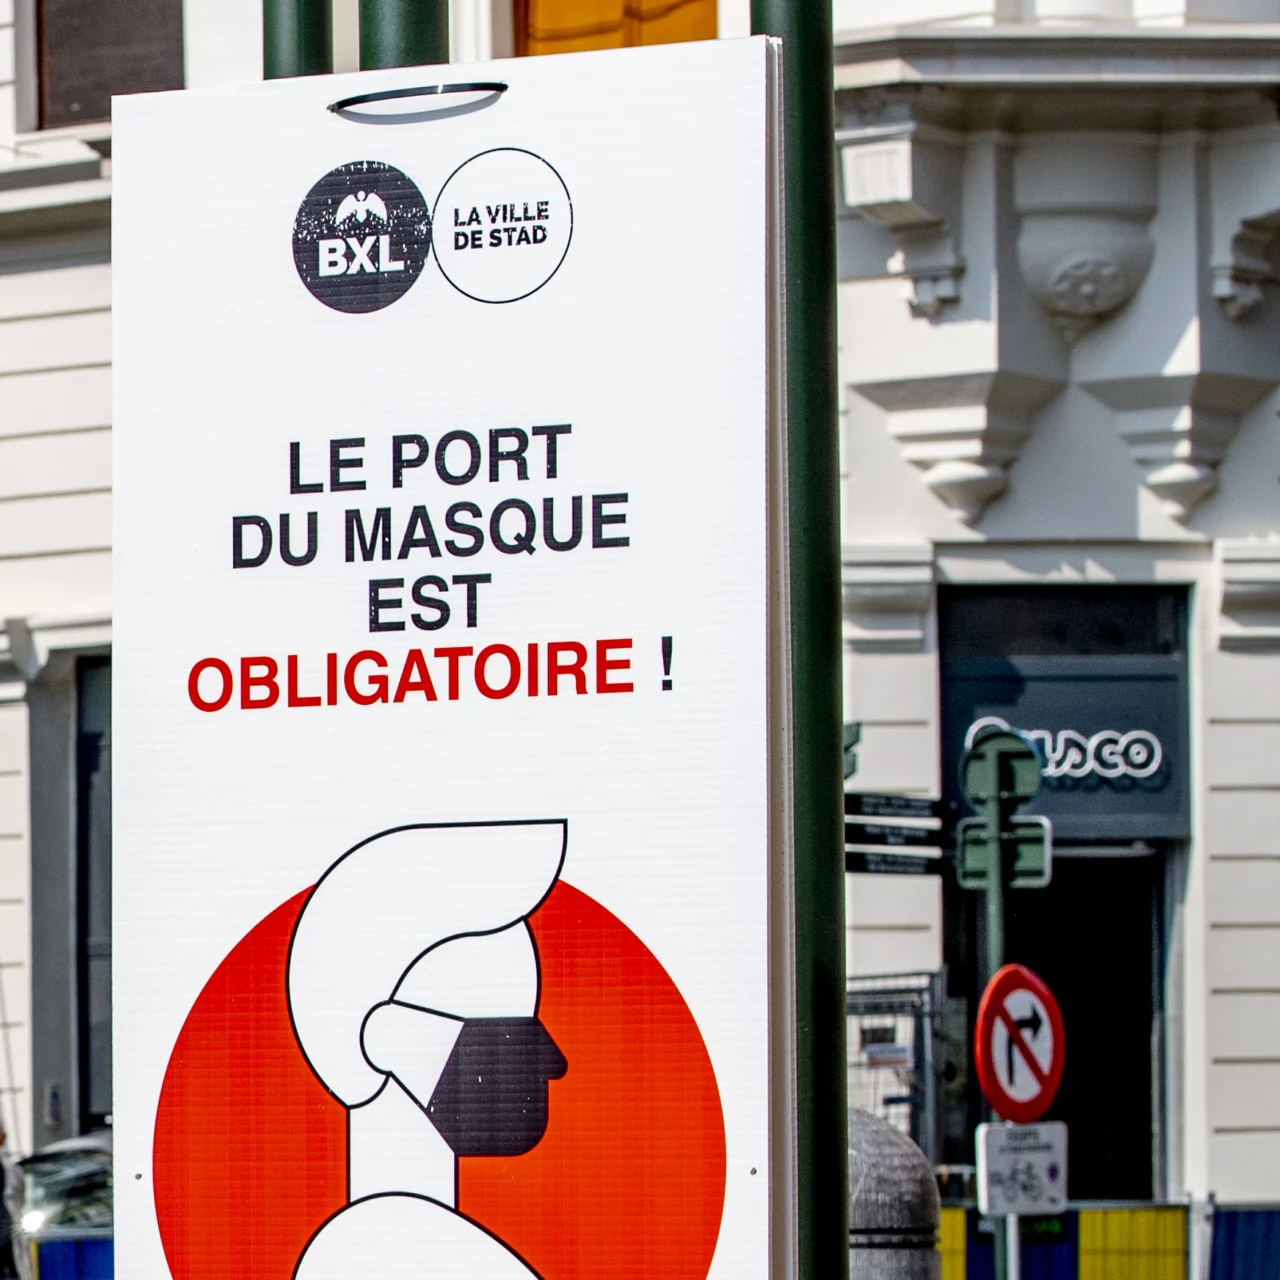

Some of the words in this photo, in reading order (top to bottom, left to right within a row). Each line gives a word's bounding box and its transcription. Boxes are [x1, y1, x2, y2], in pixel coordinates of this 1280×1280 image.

[454, 206, 482, 227] LA
[486, 201, 550, 225] VILLE
[454, 229, 483, 251] DE
[488, 225, 548, 248] STAD
[318, 234, 405, 277] BXL
[289, 437, 368, 495] LE
[392, 424, 572, 489] PORT
[232, 512, 318, 569] DU
[344, 493, 630, 563] MASQUE
[368, 574, 492, 633] EST
[187, 639, 634, 713] OBLIGATOIRE
[661, 635, 674, 692] !
